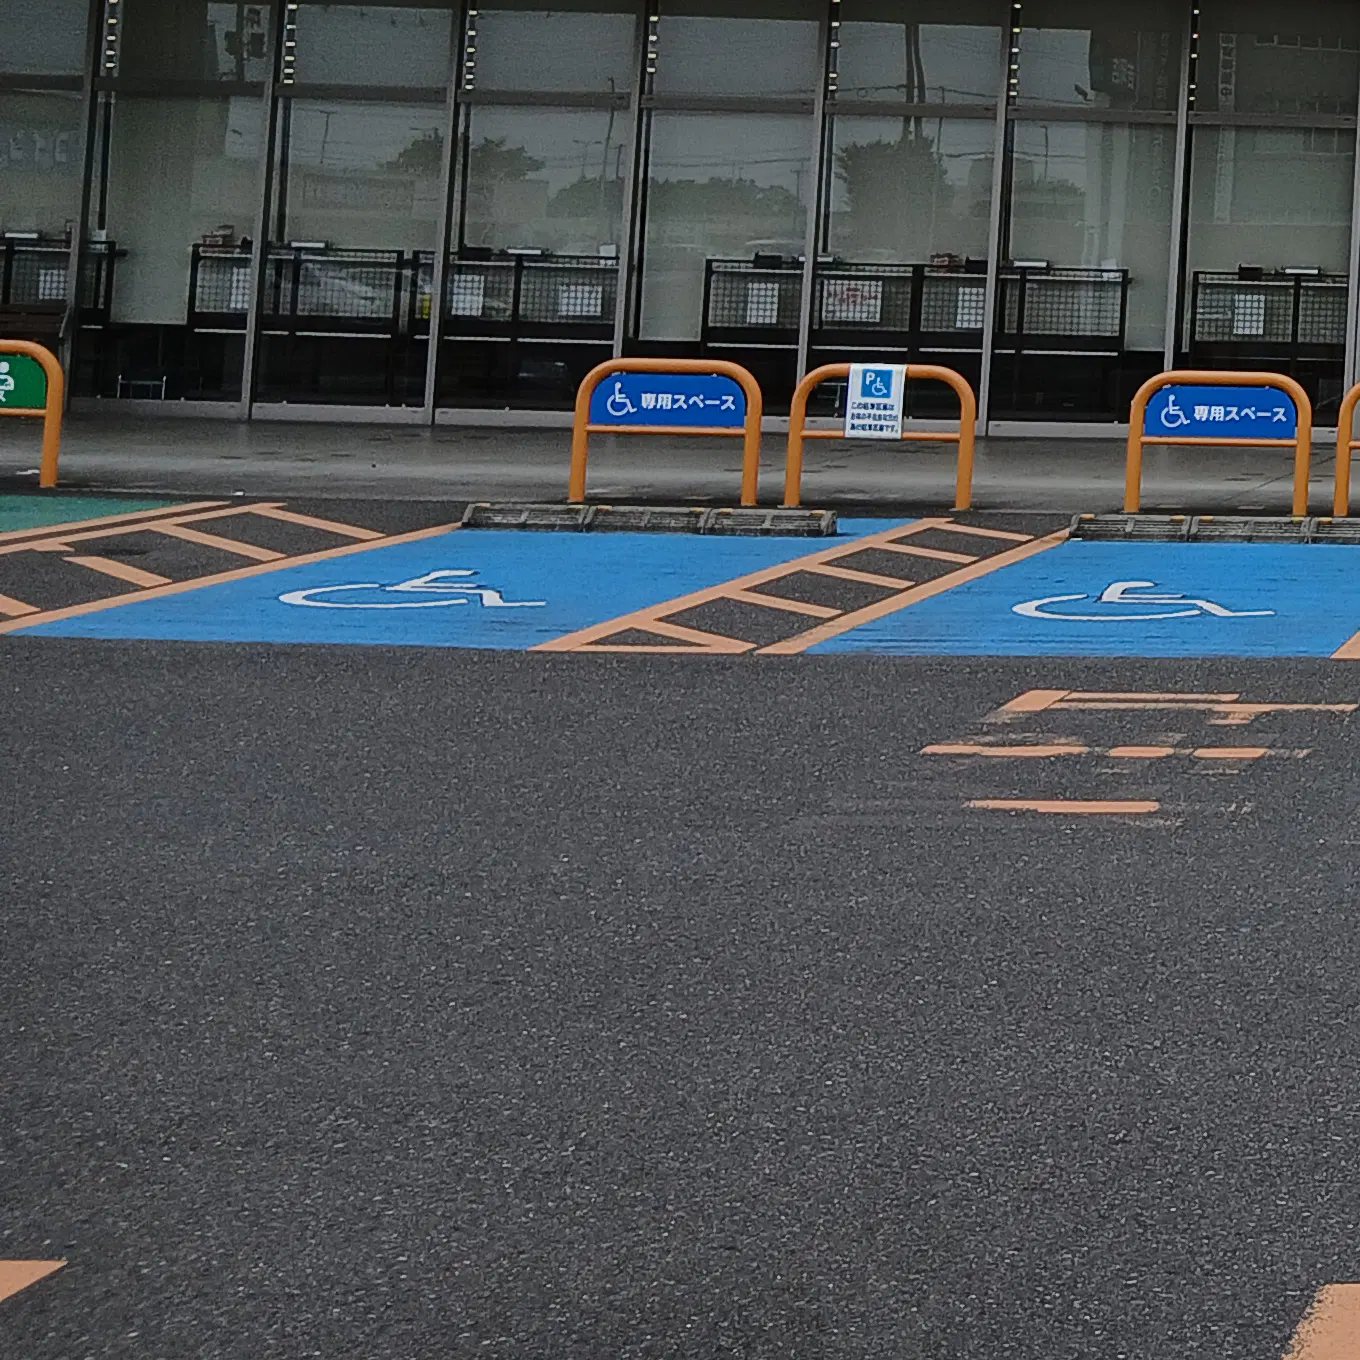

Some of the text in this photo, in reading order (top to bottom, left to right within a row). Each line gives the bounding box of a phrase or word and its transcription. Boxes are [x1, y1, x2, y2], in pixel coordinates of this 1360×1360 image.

[866, 371, 876, 386] P
[641, 393, 736, 411] 専用スペース
[1193, 405, 1288, 422] 専用スペース
